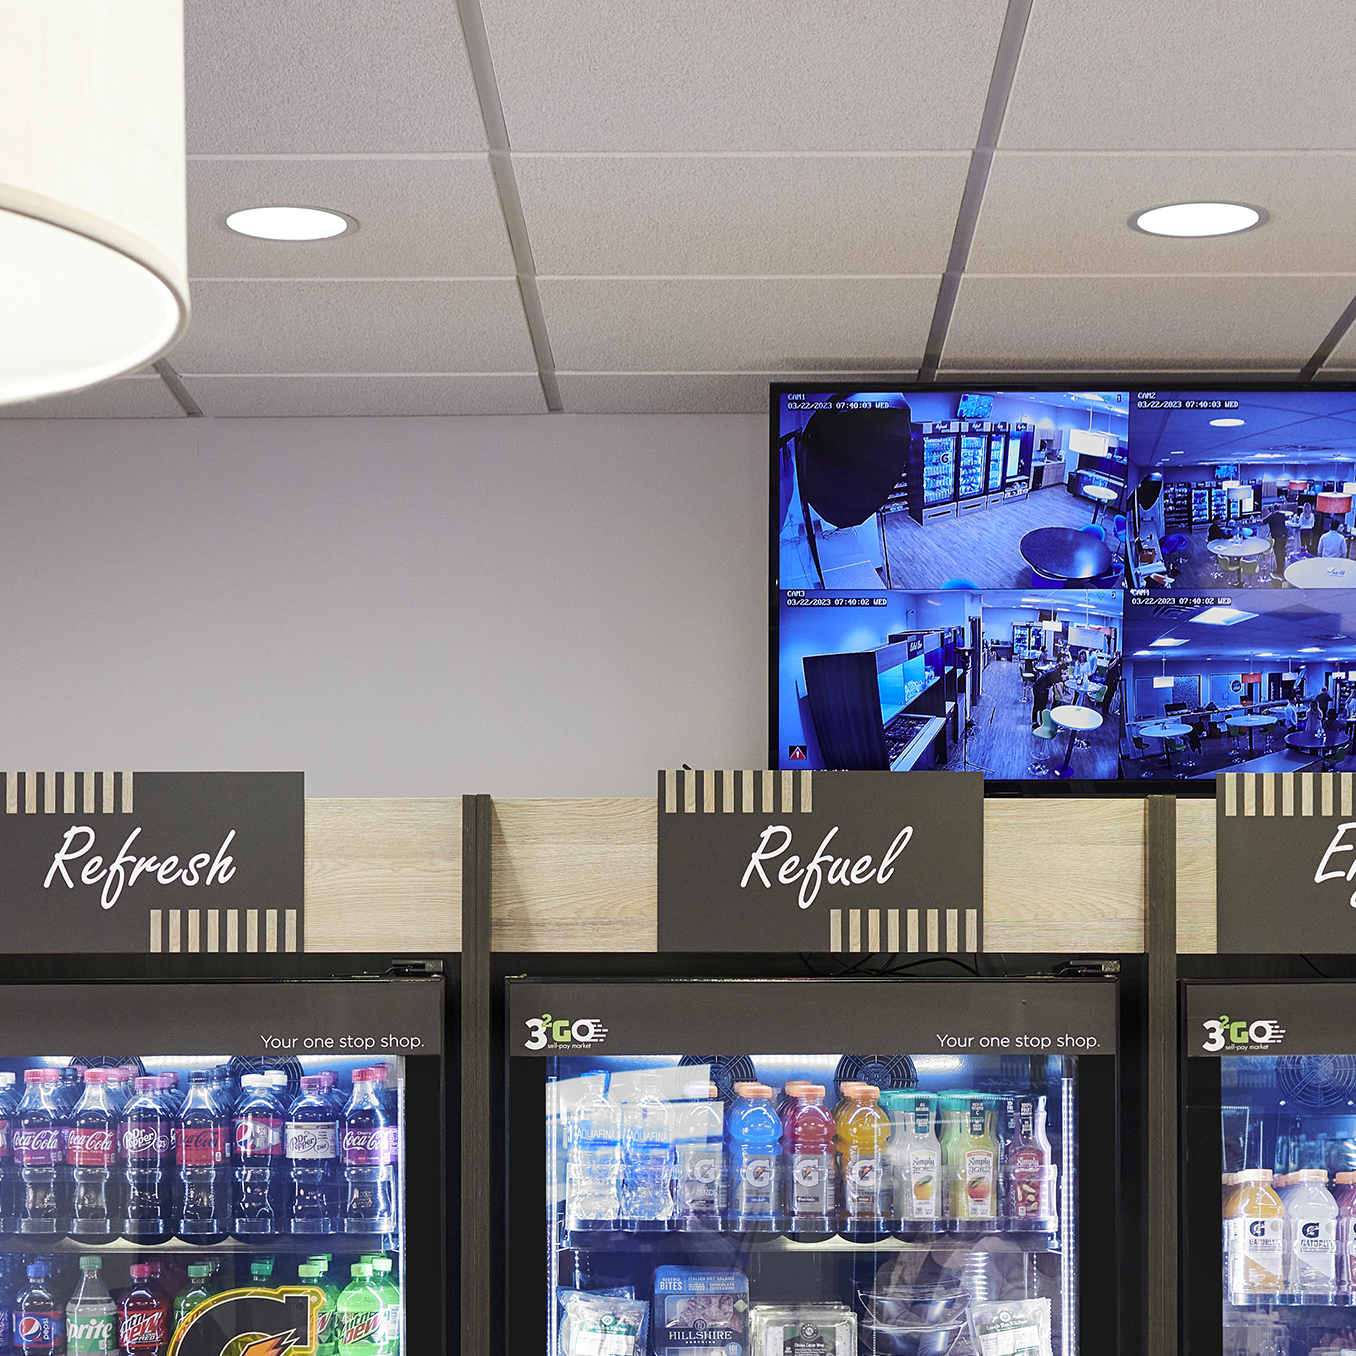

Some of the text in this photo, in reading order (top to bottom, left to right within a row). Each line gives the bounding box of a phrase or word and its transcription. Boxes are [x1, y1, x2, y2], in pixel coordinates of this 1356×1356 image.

[1138, 401, 1239, 409] 03/22/2023 07:40:03 WED
[787, 598, 831, 606] 03/22/2023
[873, 598, 887, 606] WED
[44, 826, 236, 909] Refresh
[741, 825, 913, 909] Refuel
[261, 1034, 425, 1052] Your one stop shop.
[547, 1042, 592, 1051] self-pay market
[937, 1033, 1100, 1051] Your one stop shop.
[13, 1130, 58, 1150] Coca-Cola
[68, 1130, 113, 1150] Coca-Cola
[577, 1129, 616, 1139] AQUAFINA
[629, 1131, 668, 1141] AQUAFINA
[912, 1157, 934, 1168] Simply
[968, 1157, 991, 1168] Simply
[1017, 1157, 1039, 1168] Simply
[746, 1159, 771, 1188] G
[795, 1159, 820, 1188] G
[1302, 1222, 1319, 1238] G
[669, 1331, 733, 1340] HILLSHIRE
